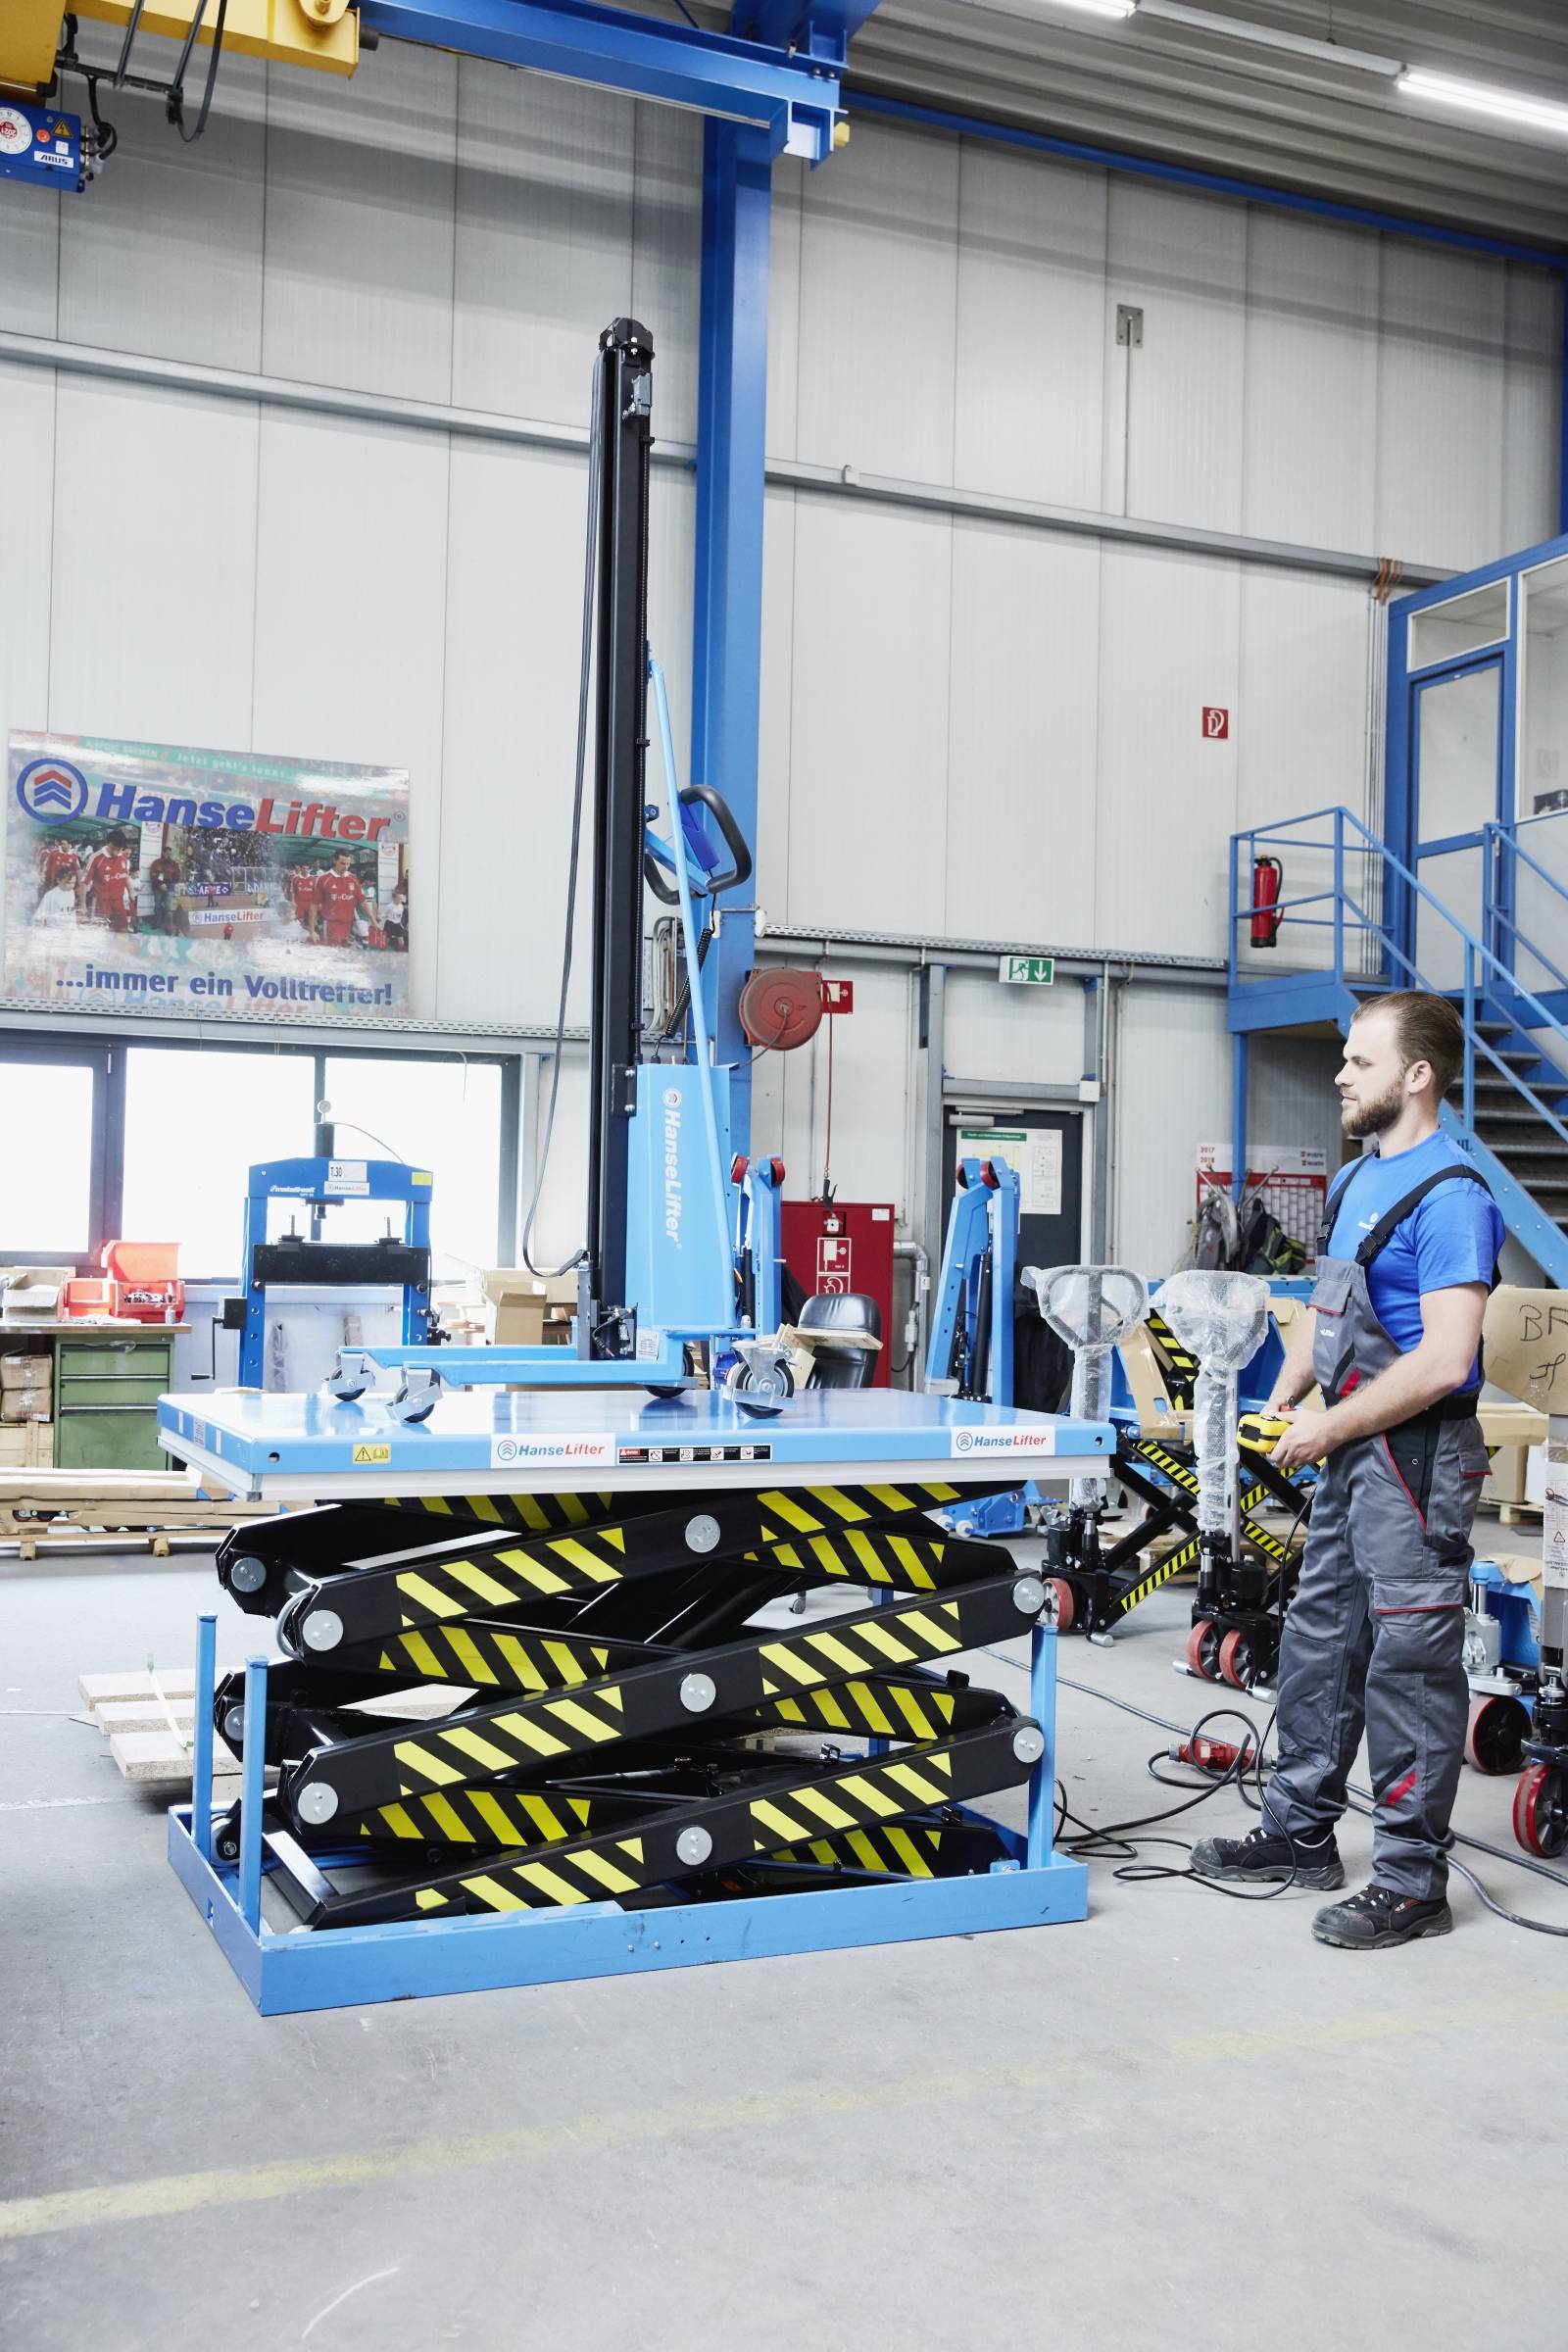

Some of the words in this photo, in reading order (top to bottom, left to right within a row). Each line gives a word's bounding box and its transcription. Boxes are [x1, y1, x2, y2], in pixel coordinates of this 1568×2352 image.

[40, 154, 69, 166] ABUS
[98, 782, 391, 842] HanseLifter
[204, 910, 264, 922] HanseLifter
[189, 971, 233, 997] ein
[244, 975, 392, 1006] Volltreffer!
[664, 1108, 683, 1244] HanseLifter
[974, 1435, 1047, 1446] HanseLifter
[518, 1443, 606, 1456] HanseLifter
